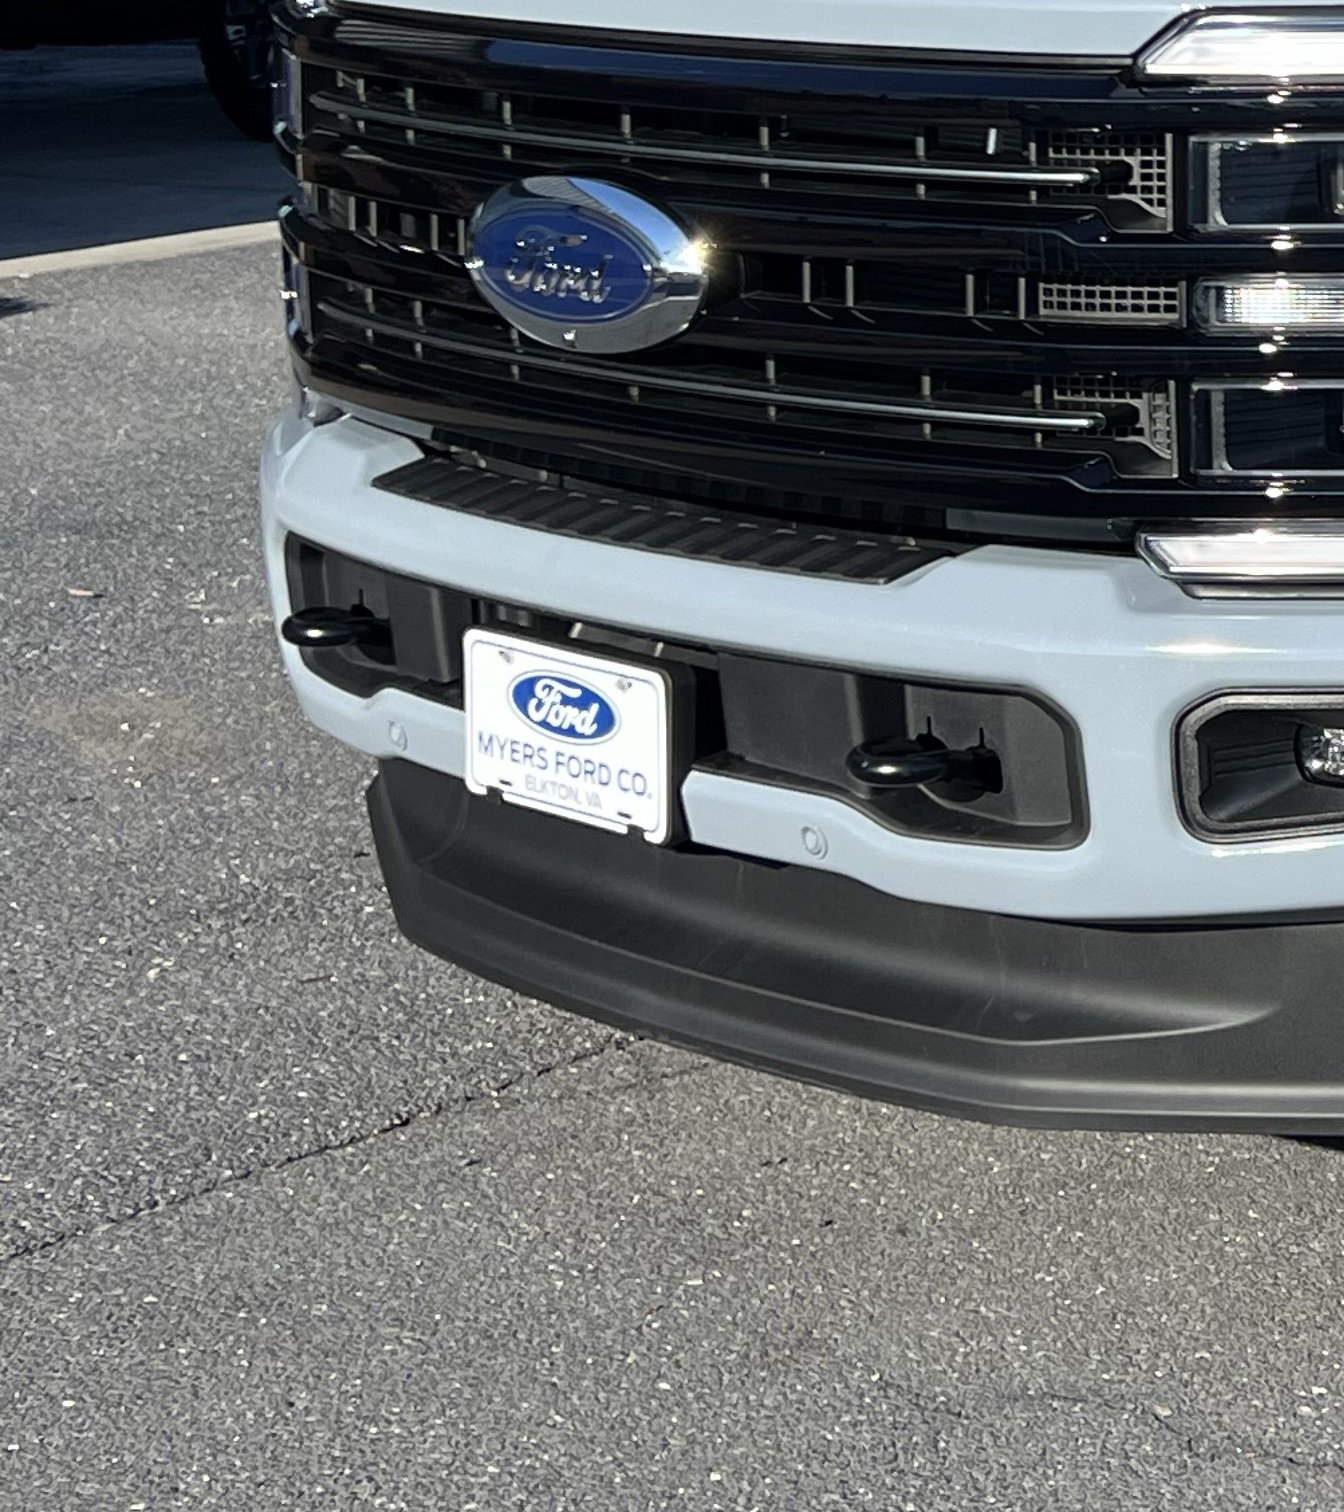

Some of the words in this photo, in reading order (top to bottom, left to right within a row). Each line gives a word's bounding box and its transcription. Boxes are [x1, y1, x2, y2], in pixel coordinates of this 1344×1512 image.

[505, 225, 614, 303] Ford
[528, 679, 599, 736] Ford
[477, 731, 548, 770] MYERS
[554, 752, 611, 786] FORD
[618, 769, 653, 799] CO.
[586, 790, 602, 809] VA
